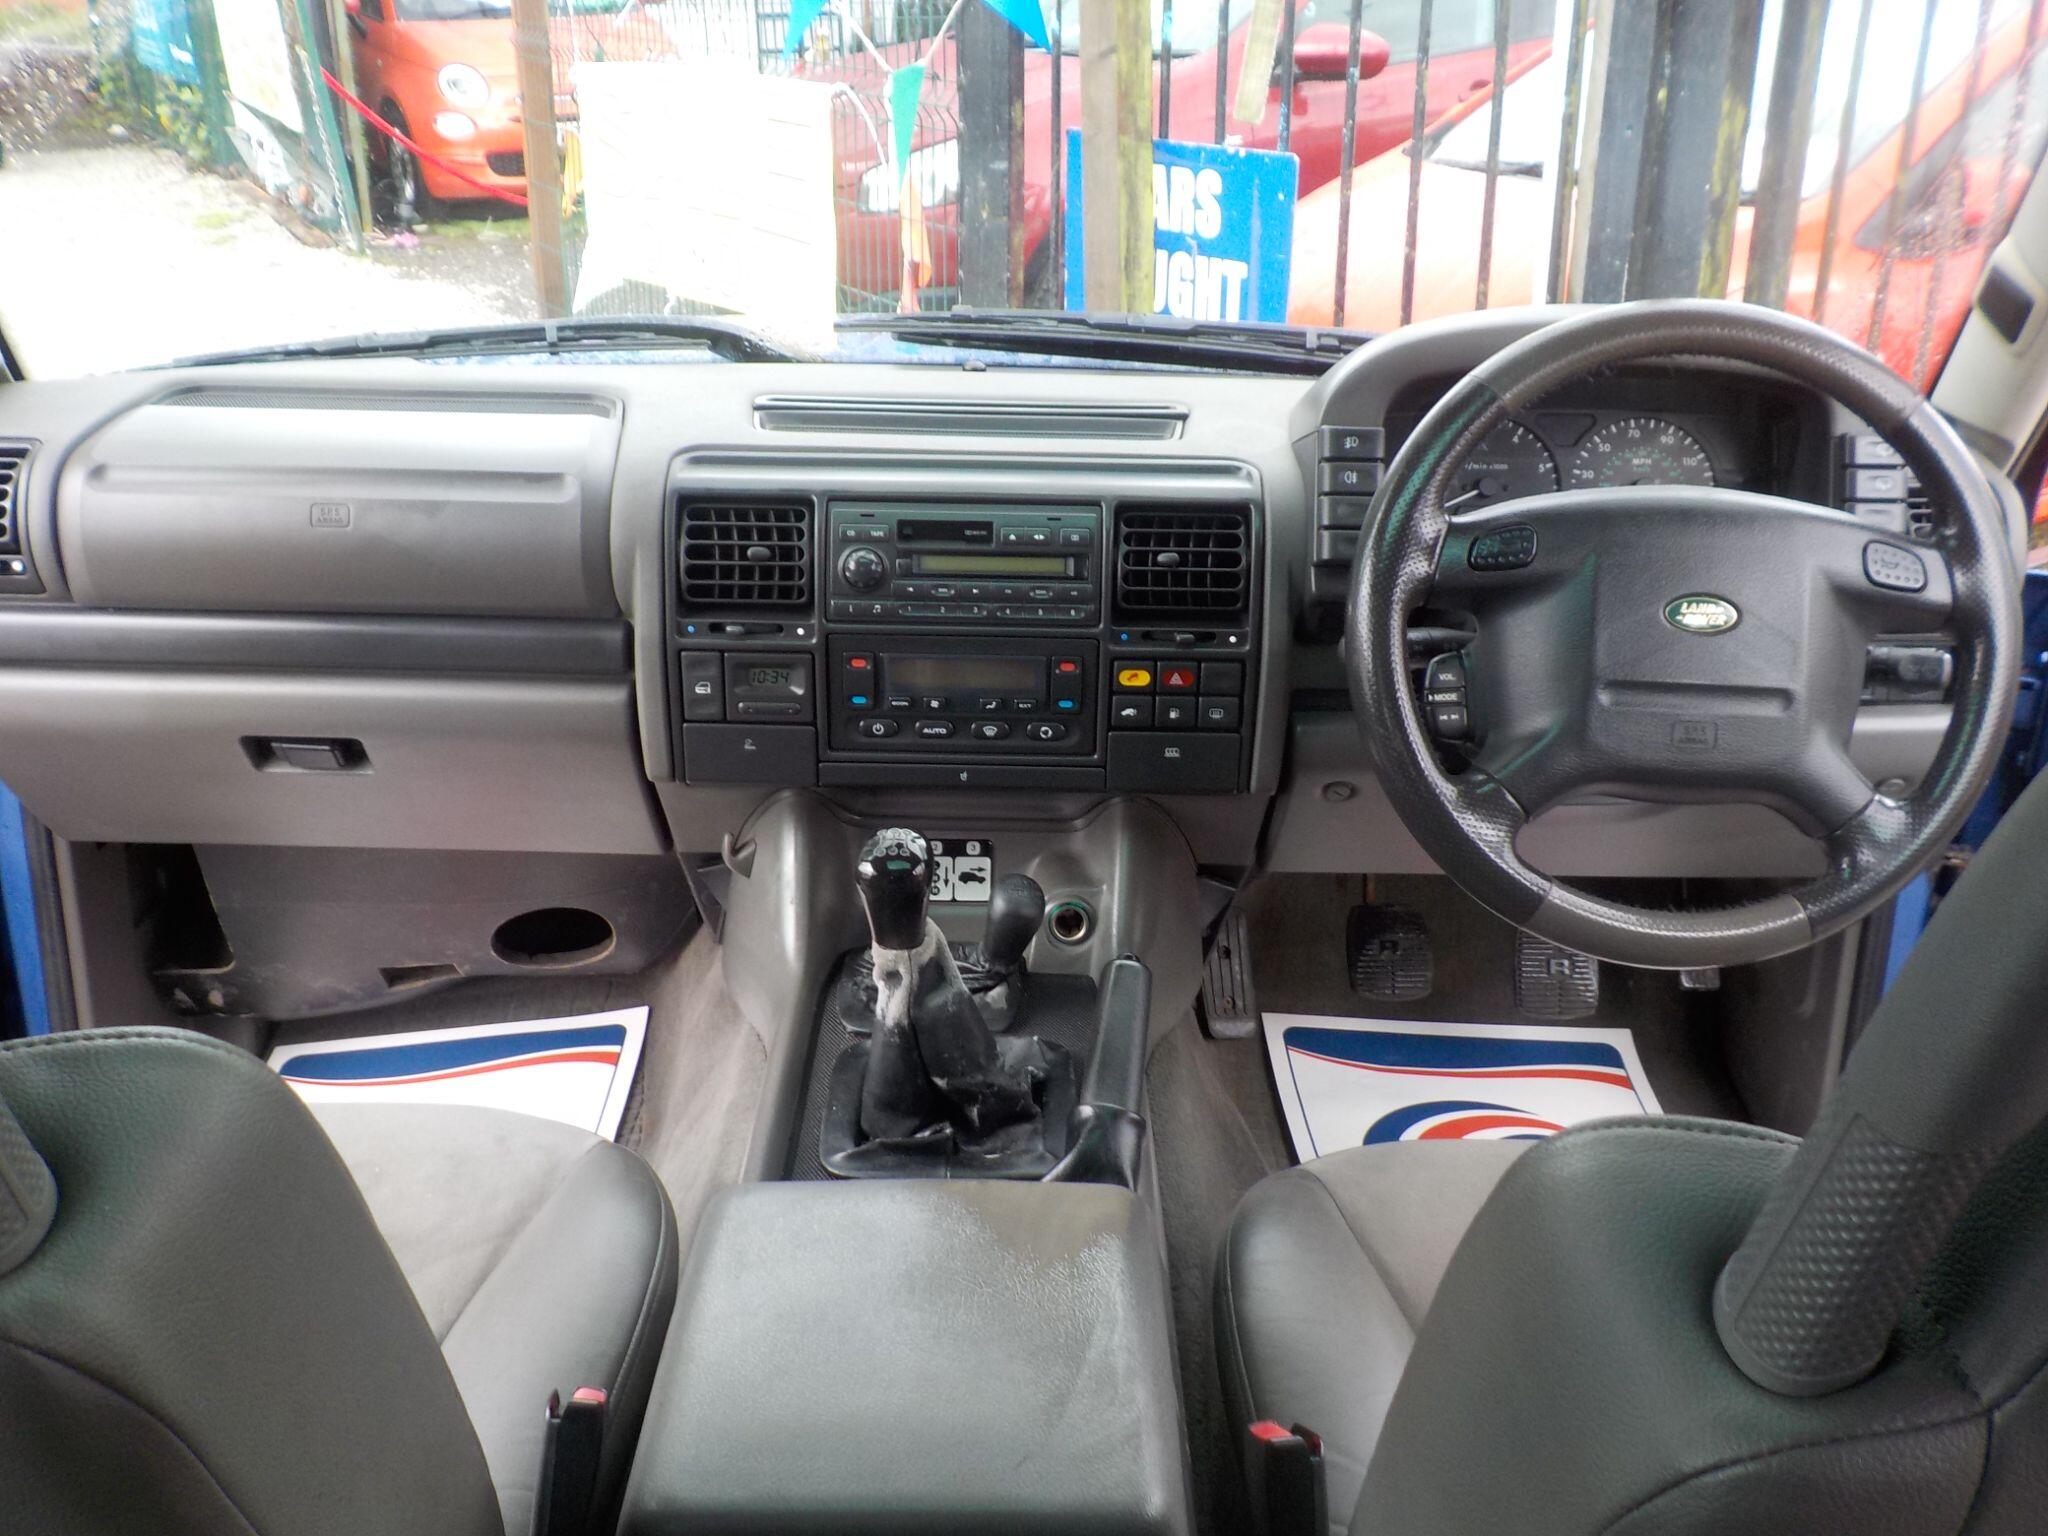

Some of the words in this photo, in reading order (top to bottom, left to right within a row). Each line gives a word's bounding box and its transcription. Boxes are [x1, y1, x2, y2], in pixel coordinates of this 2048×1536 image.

[1153, 164, 1223, 239] ARS
[1627, 429, 1641, 438] 70
[1660, 435, 1675, 444] 90
[1598, 443, 1612, 452] 50
[1682, 457, 1698, 466] 110
[1581, 470, 1595, 479] 30
[750, 670, 790, 684] 10:34
[1433, 692, 1459, 701] MODE
[922, 727, 948, 735] AUTO
